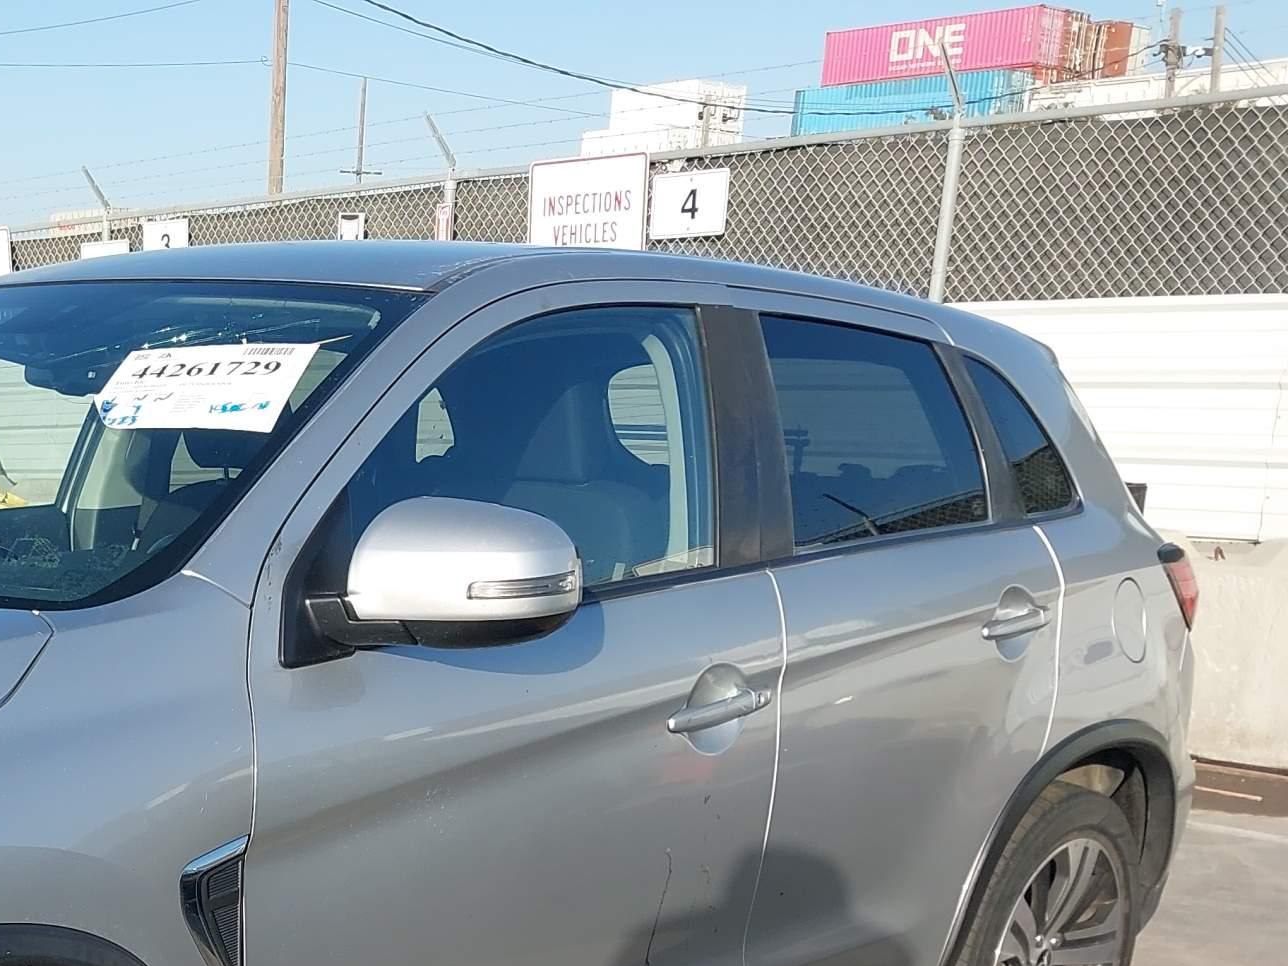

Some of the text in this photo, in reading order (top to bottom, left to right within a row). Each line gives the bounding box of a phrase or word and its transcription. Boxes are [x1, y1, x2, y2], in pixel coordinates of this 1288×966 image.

[889, 23, 966, 62] ONE
[543, 189, 632, 217] INSPECTIONS
[681, 188, 699, 219] 4
[553, 222, 618, 246] VEHICLES
[131, 360, 282, 379] 44261729
